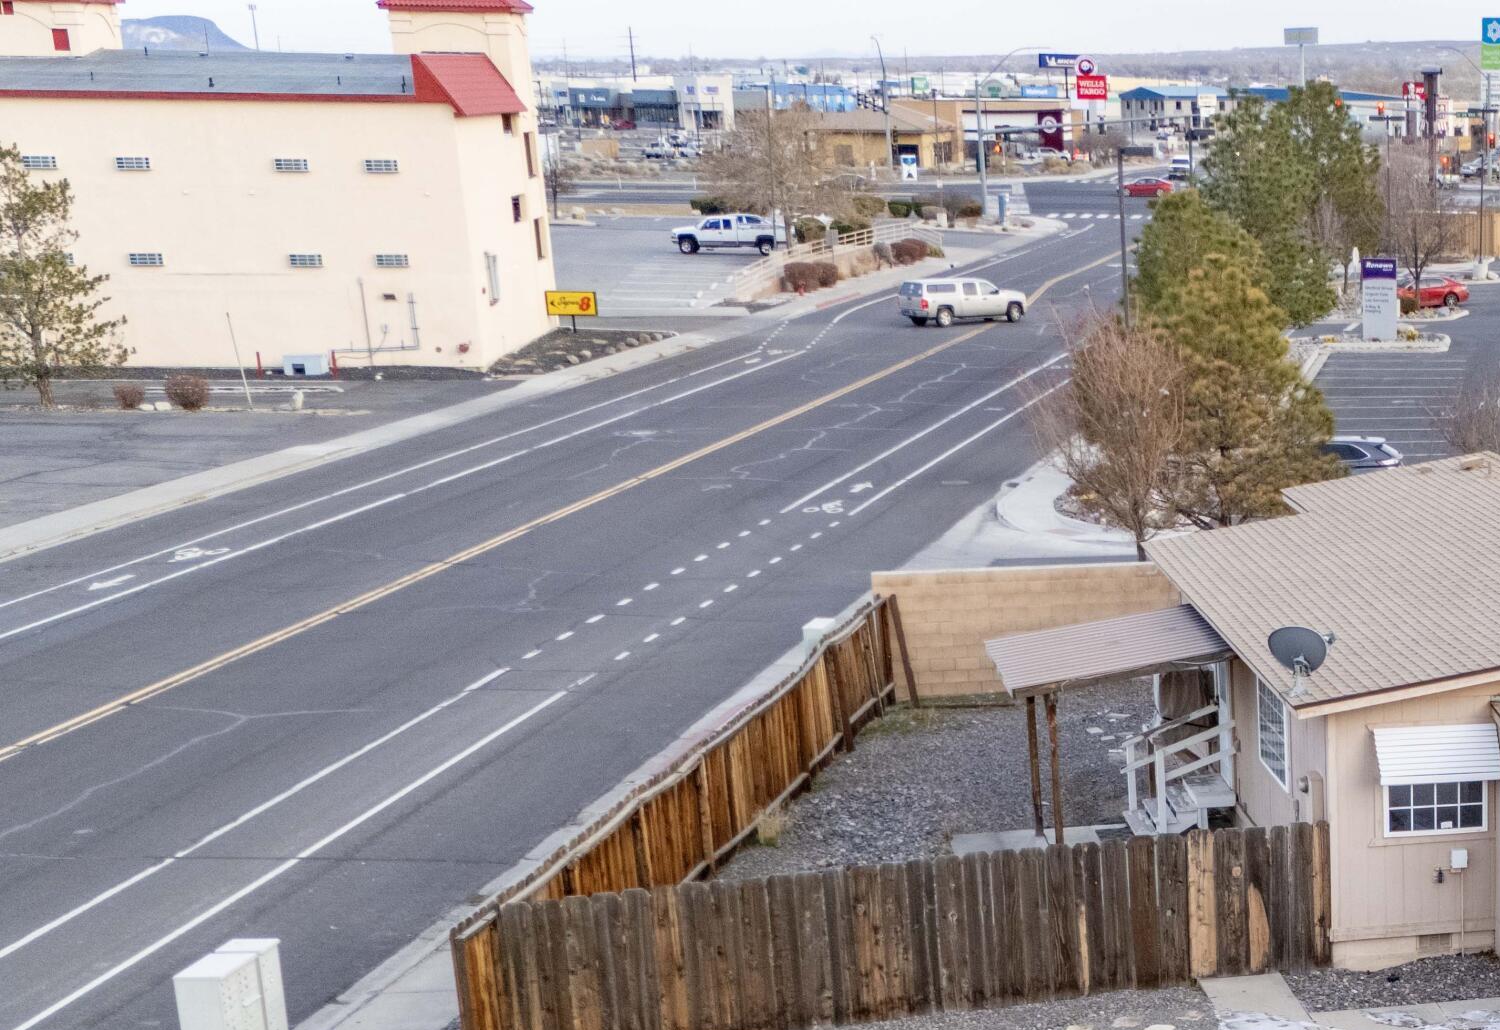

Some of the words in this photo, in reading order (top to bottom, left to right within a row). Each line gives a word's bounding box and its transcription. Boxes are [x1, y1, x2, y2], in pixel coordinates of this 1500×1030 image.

[1078, 80, 1104, 88] WELLS
[1080, 88, 1105, 96] FARGO
[1365, 261, 1394, 269] Renown
[579, 296, 592, 312] 8
